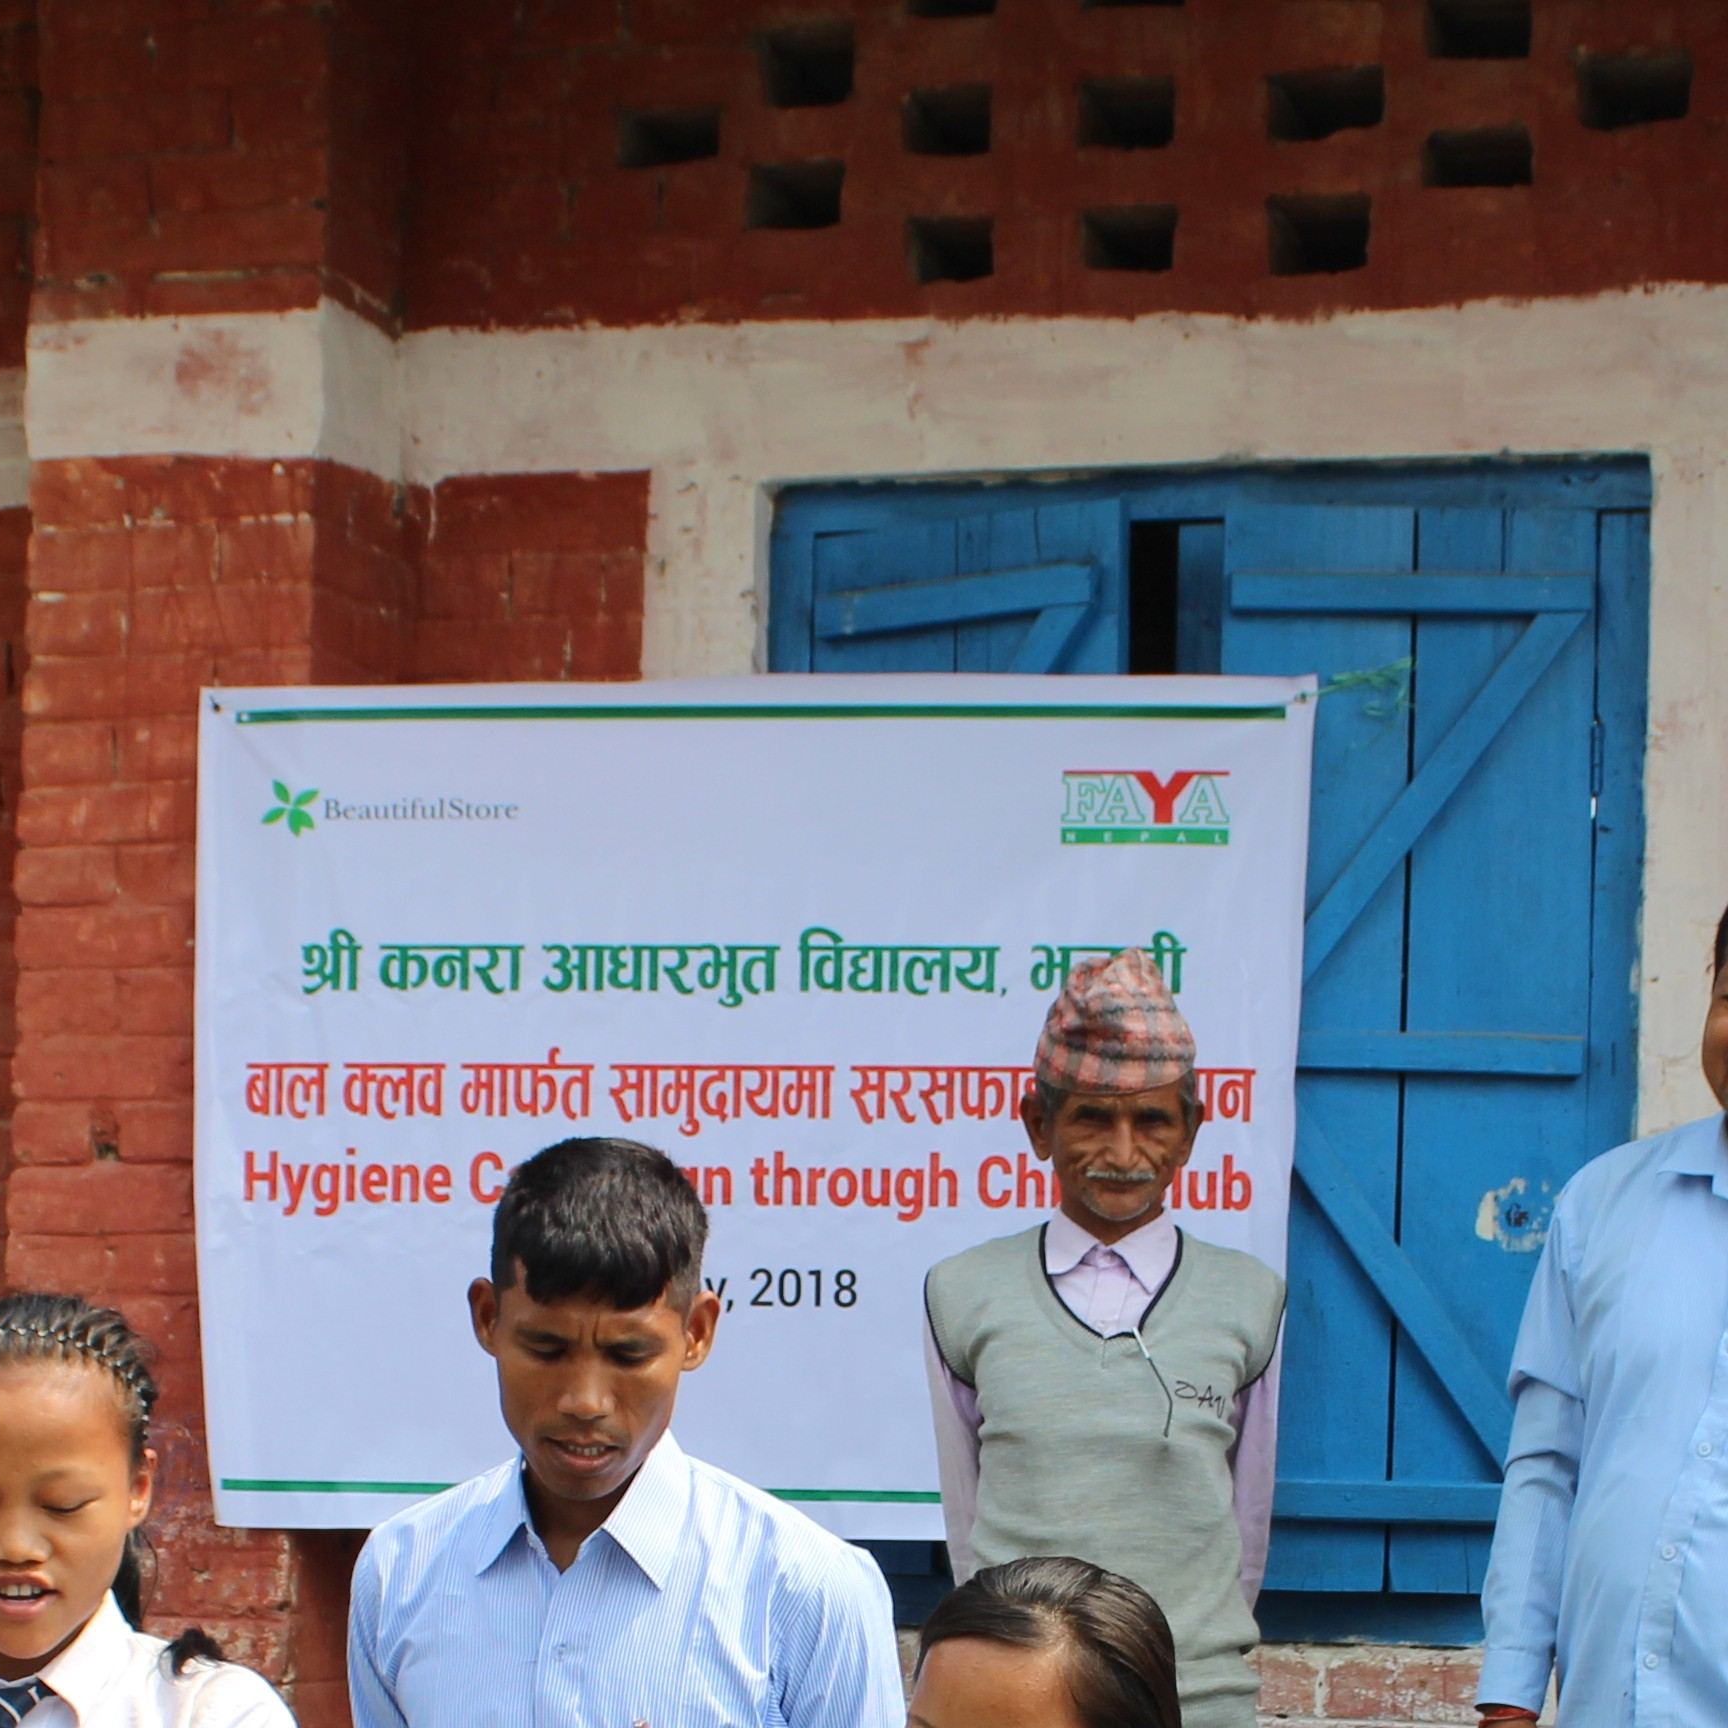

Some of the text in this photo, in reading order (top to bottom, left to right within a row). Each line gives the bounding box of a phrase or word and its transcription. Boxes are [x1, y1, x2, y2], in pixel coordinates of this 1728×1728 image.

[323, 797, 520, 820] BeautifulStore
[1061, 769, 1230, 824] FAYA
[1064, 830, 1223, 844] NEPAL
[301, 928, 362, 995] श्री
[379, 944, 525, 994] कनरा
[542, 943, 780, 1007] आधारभुत
[246, 1063, 329, 1119] बाल
[460, 1047, 594, 1119] मार्फत
[608, 1064, 834, 1136] सामुदायमा
[850, 1065, 1037, 1126] सरसफा
[243, 1147, 453, 1217] Hygiene
[749, 1151, 959, 1221] through
[1170, 1153, 1252, 1211] lub
[749, 1267, 857, 1308] 2018
